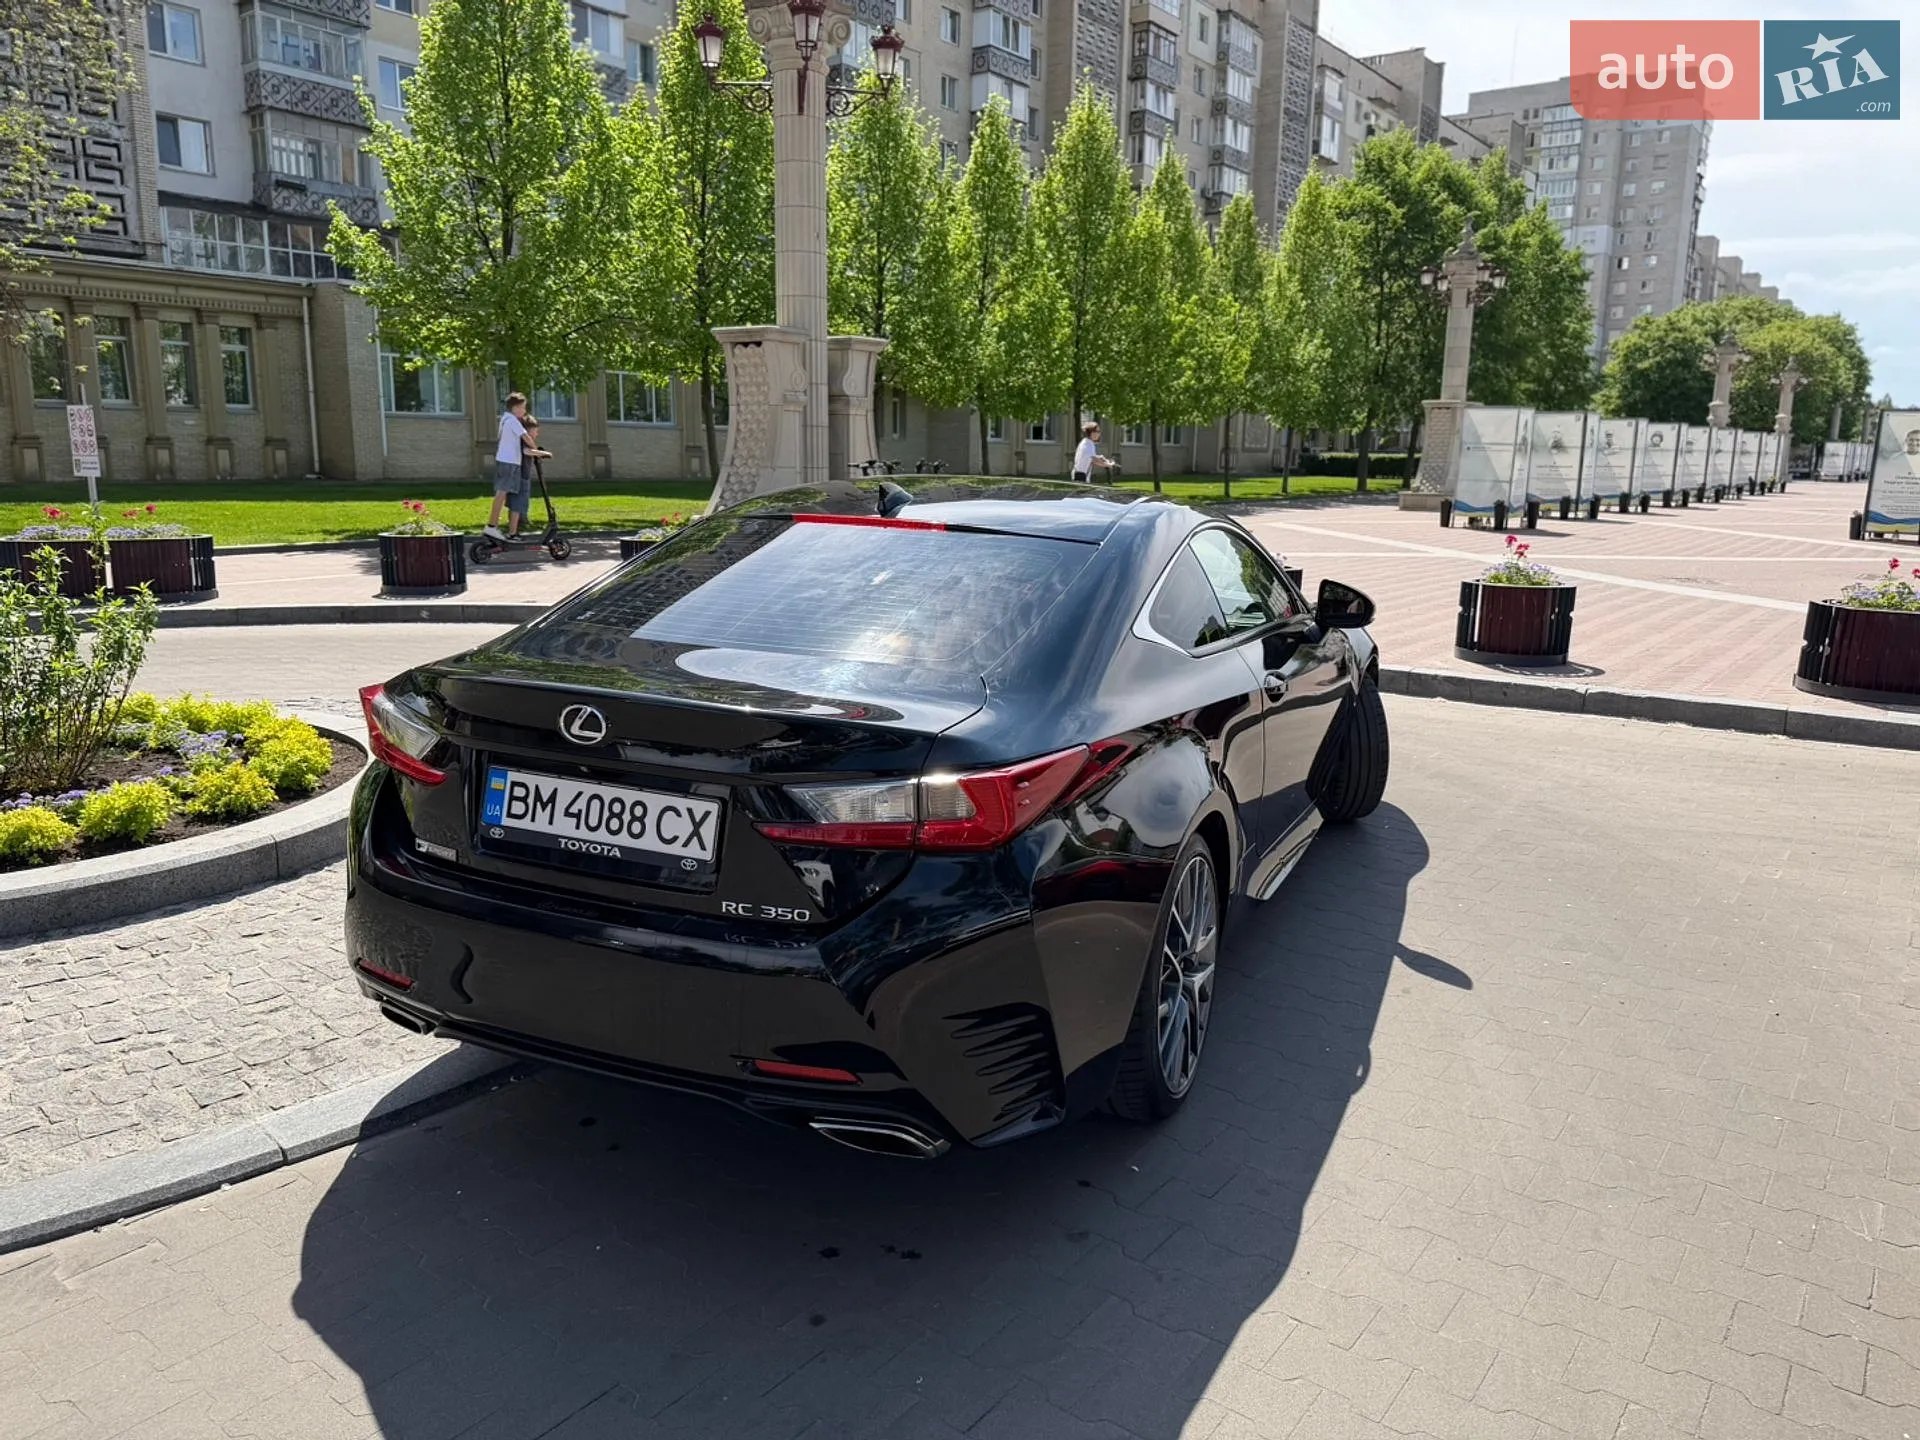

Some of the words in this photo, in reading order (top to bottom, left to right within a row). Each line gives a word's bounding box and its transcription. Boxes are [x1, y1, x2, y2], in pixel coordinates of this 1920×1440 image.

[486, 803, 501, 817] UA
[506, 781, 558, 826] BM
[564, 791, 648, 840] 4088
[656, 805, 712, 852] CX
[558, 838, 622, 858] TOYOTA
[721, 901, 753, 916] RC
[760, 905, 810, 922] 350
